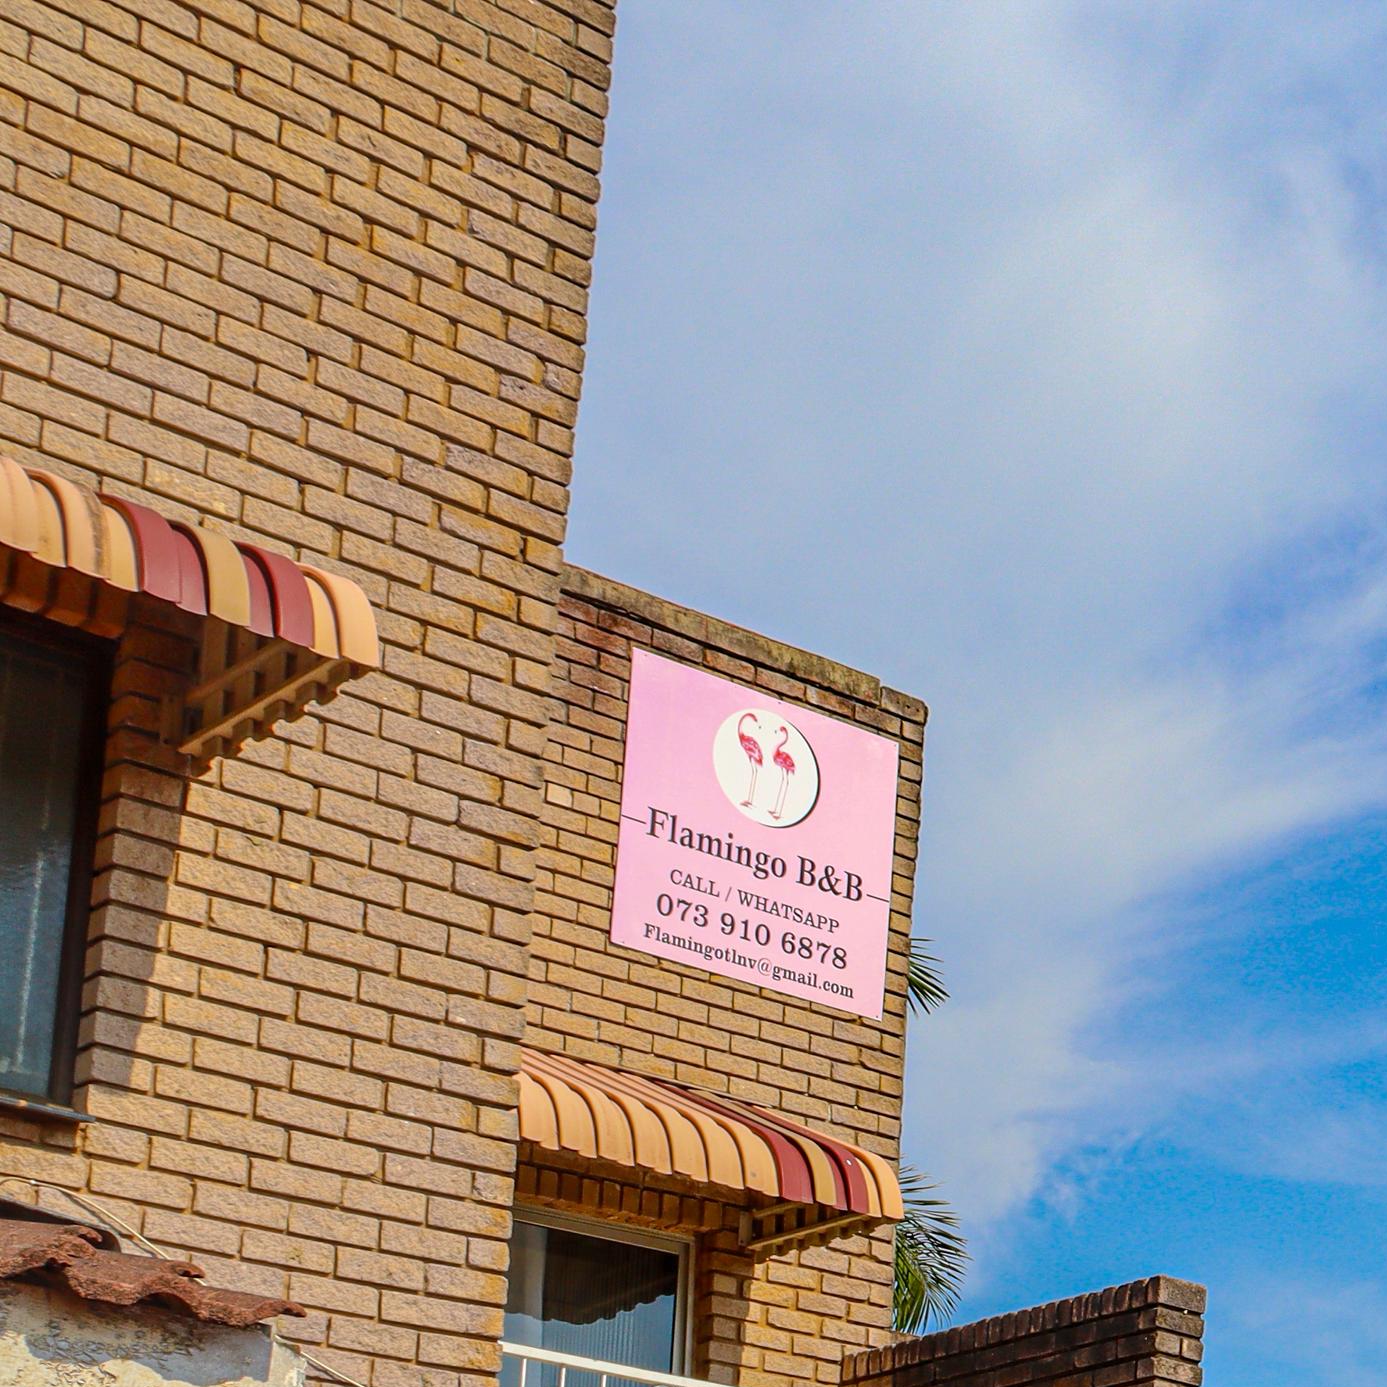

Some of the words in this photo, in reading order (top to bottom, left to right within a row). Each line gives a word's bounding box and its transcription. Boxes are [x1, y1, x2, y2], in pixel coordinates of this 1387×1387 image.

[645, 806, 787, 880] Flamingo
[795, 854, 864, 903] B&B
[655, 892, 709, 928] 073
[719, 911, 771, 948] 910
[780, 930, 849, 970] 6878
[669, 868, 720, 898] CALL
[724, 886, 734, 902] /
[737, 889, 841, 934] WHATSAPP
